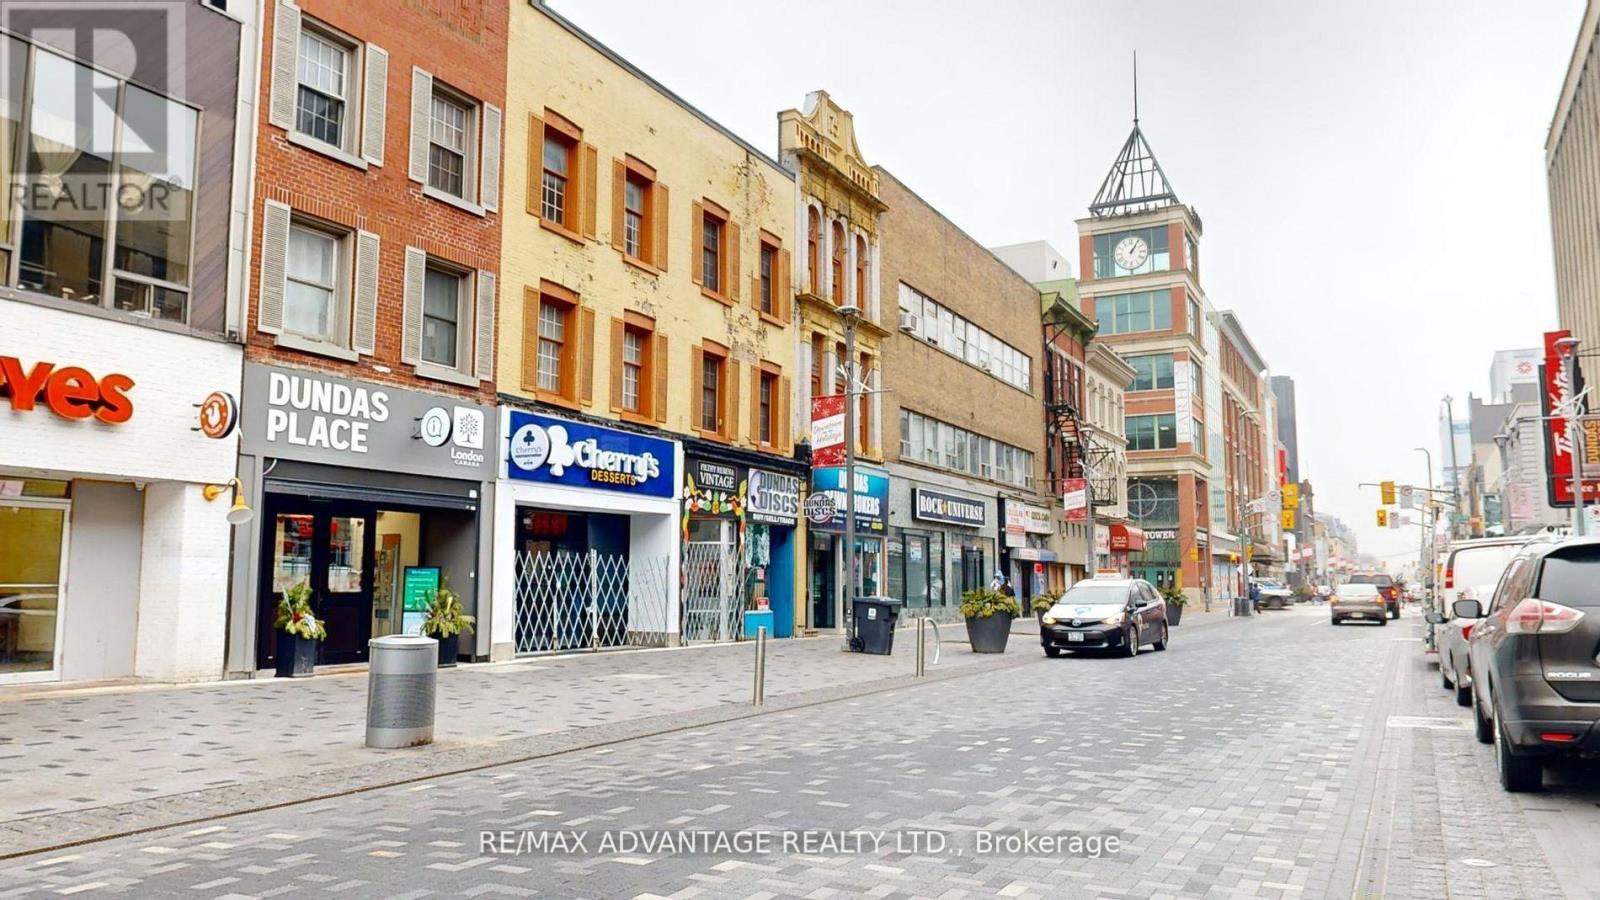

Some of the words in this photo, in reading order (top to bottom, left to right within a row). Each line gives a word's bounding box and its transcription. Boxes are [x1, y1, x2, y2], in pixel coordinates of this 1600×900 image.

[268, 372, 390, 423] DUNDAS
[267, 409, 370, 453] PLACE
[1585, 420, 1598, 464] DUNDAS
[451, 447, 484, 463] London
[572, 438, 660, 483] Cherry's
[591, 469, 637, 486] DESSERTS
[700, 471, 735, 489] VINTAGE
[760, 471, 799, 495] DUNDAS
[760, 491, 798, 514] DISCS
[803, 498, 836, 508] DUNDAS
[803, 507, 836, 517] DISCS
[920, 495, 943, 515] ROCK
[947, 500, 984, 521] UNIVERSE
[1145, 530, 1175, 540] TOWER
